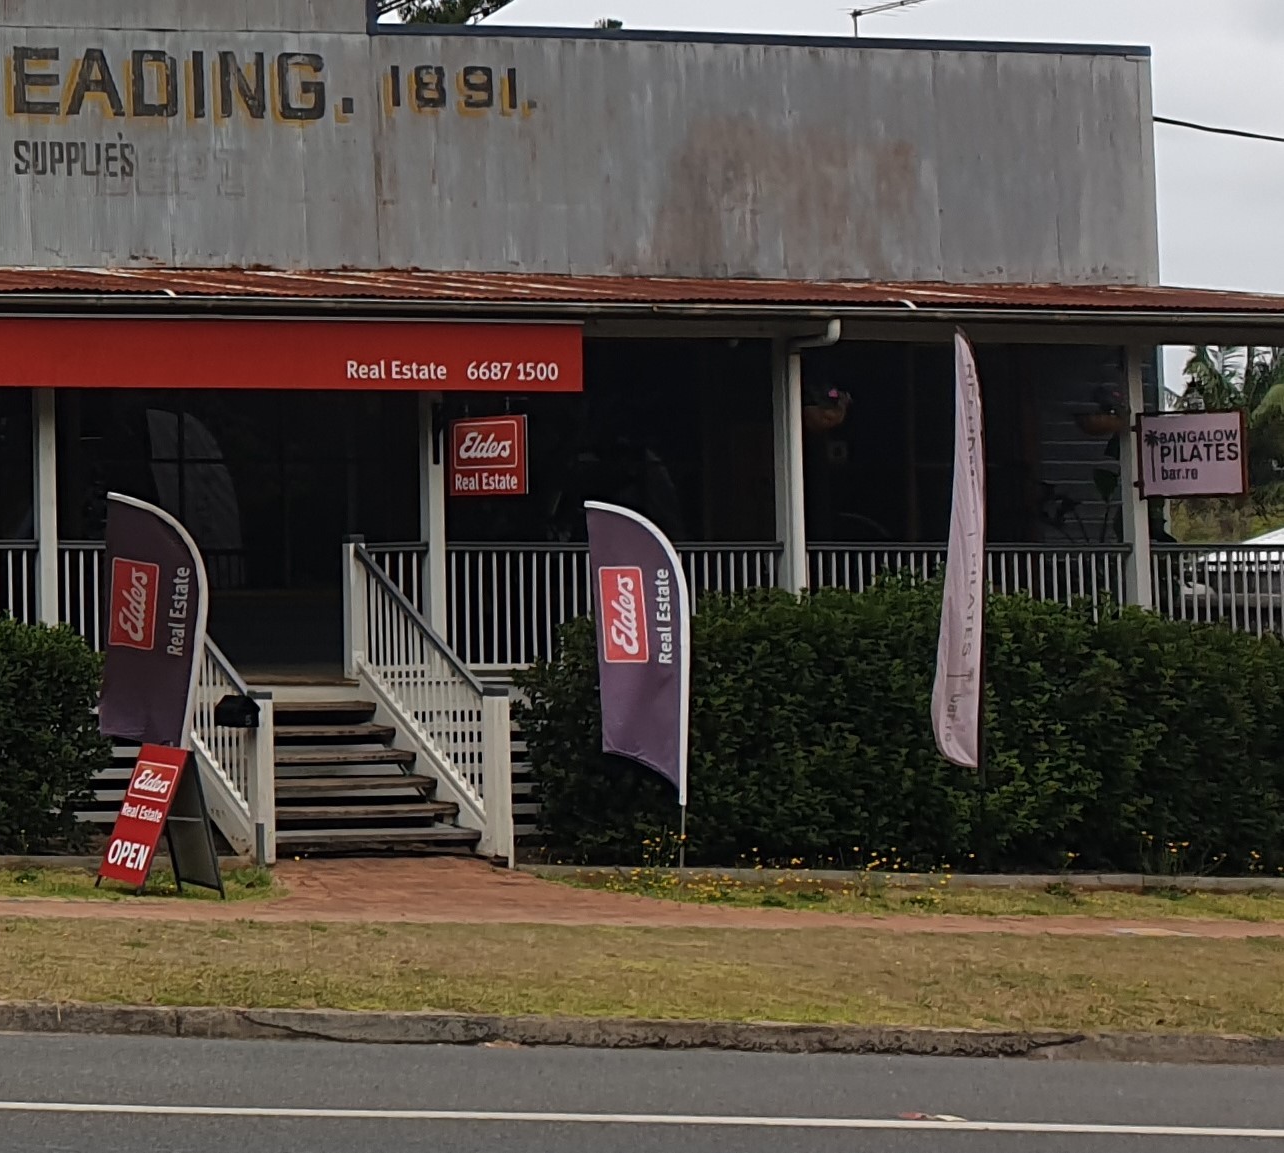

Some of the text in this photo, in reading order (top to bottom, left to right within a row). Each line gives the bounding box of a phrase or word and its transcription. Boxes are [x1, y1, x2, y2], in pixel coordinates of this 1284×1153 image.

[346, 359, 559, 381] Real Estate 6687 1500
[459, 431, 512, 459] Elders
[1159, 429, 1238, 444] BANGALOW
[1160, 442, 1239, 463] PILATES
[454, 472, 518, 491] Real Estate
[119, 567, 148, 642] Elders
[167, 567, 191, 656] Real Estate
[611, 573, 639, 655] Elders
[655, 568, 673, 664] Real Estate
[244, 714, 252, 726] 5
[133, 769, 171, 793] Elders
[121, 802, 163, 823] Real Estate
[108, 839, 150, 871] OPEN
